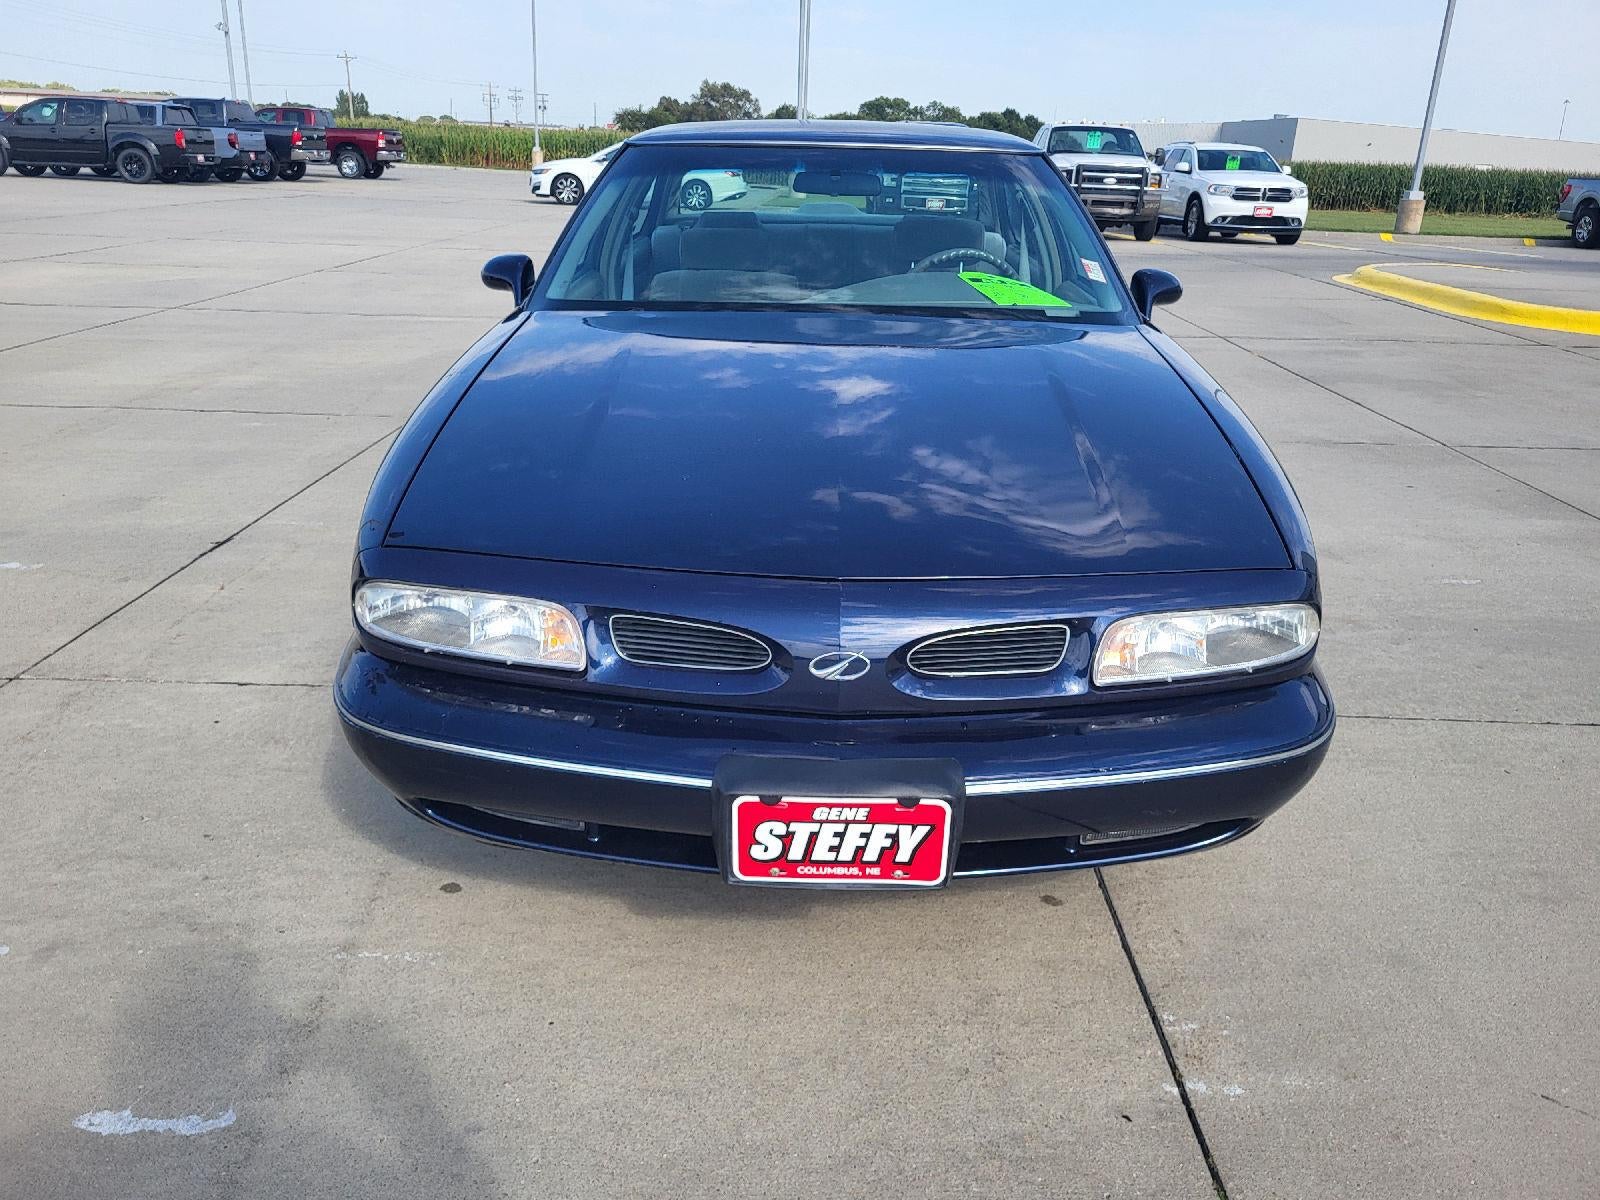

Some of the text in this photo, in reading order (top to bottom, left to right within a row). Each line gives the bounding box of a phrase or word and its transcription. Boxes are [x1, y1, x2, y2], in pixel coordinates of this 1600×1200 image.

[812, 807, 871, 821] GENE
[750, 820, 936, 865] STEFFY
[796, 865, 881, 877] COLUMBUS, NE
